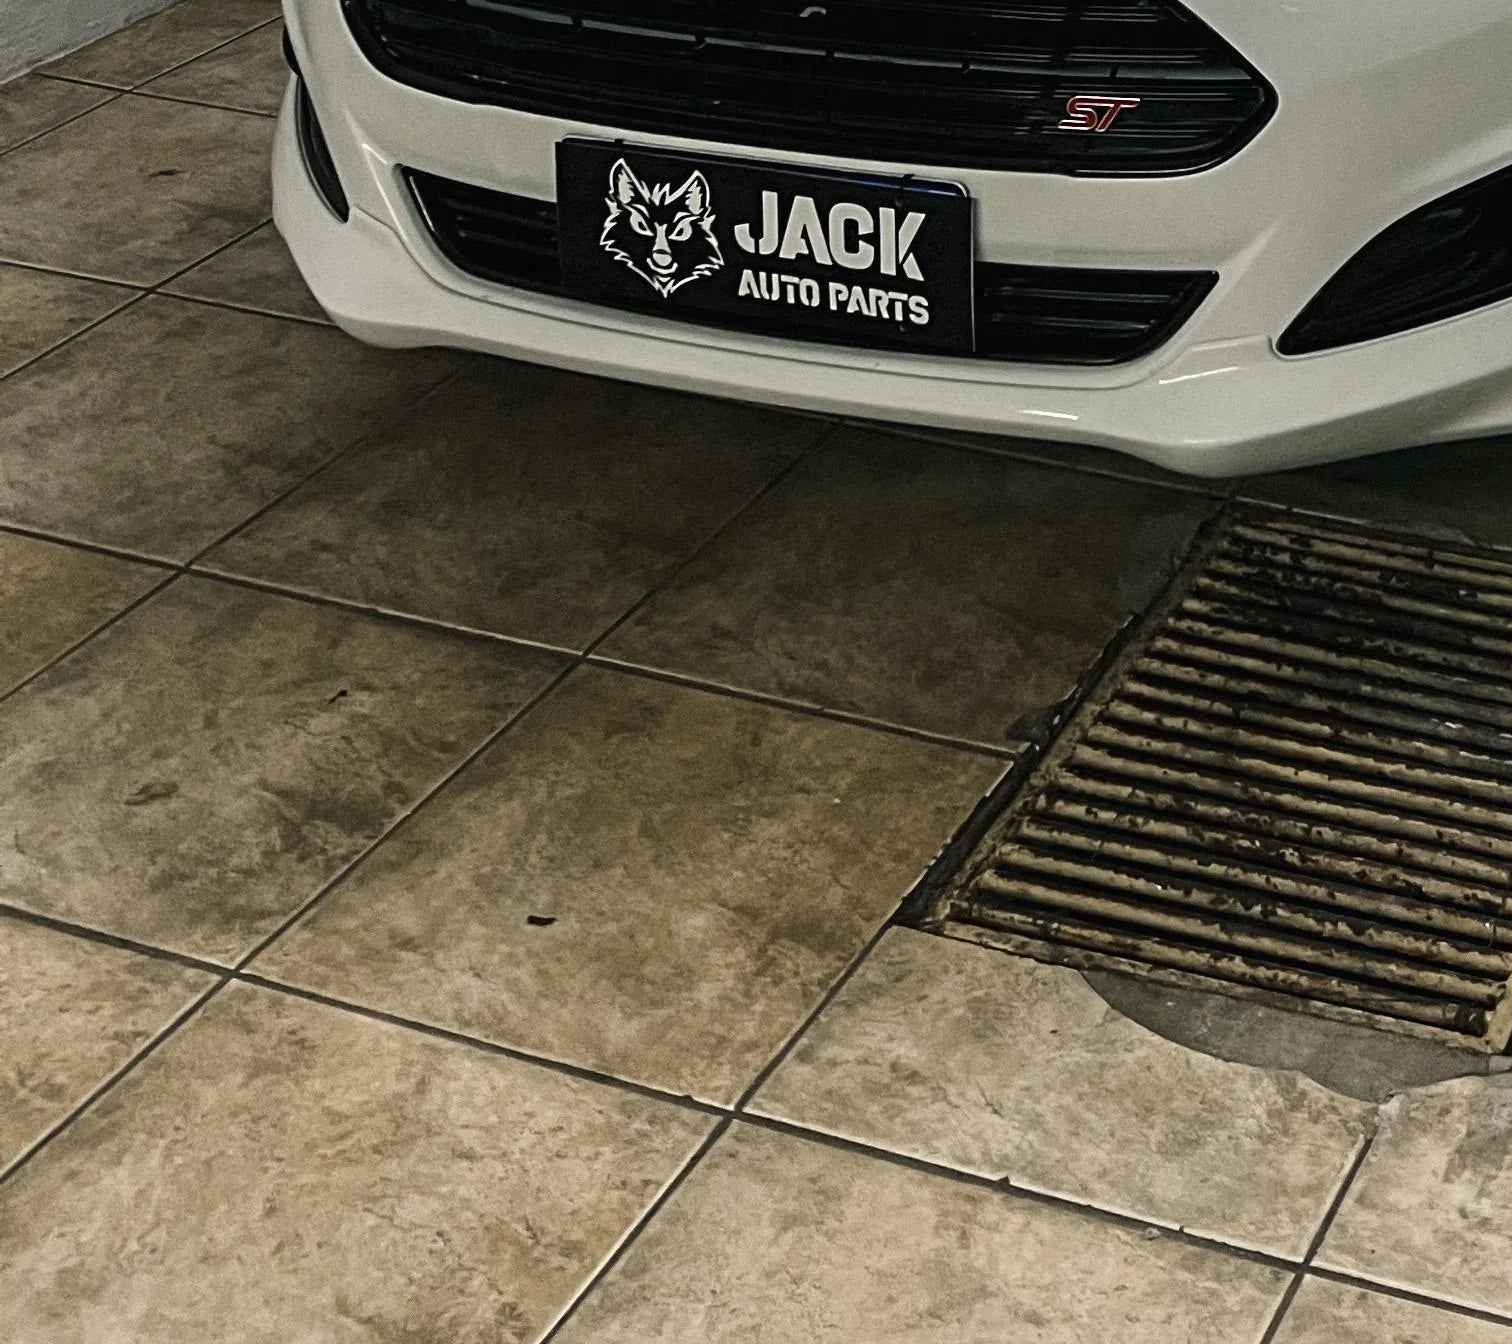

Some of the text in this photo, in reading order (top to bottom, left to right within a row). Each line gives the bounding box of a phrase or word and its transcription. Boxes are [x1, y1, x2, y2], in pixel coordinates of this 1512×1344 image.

[1057, 95, 1140, 132] ST
[734, 190, 926, 282] JACK
[738, 269, 930, 325] AUTO PARTS
